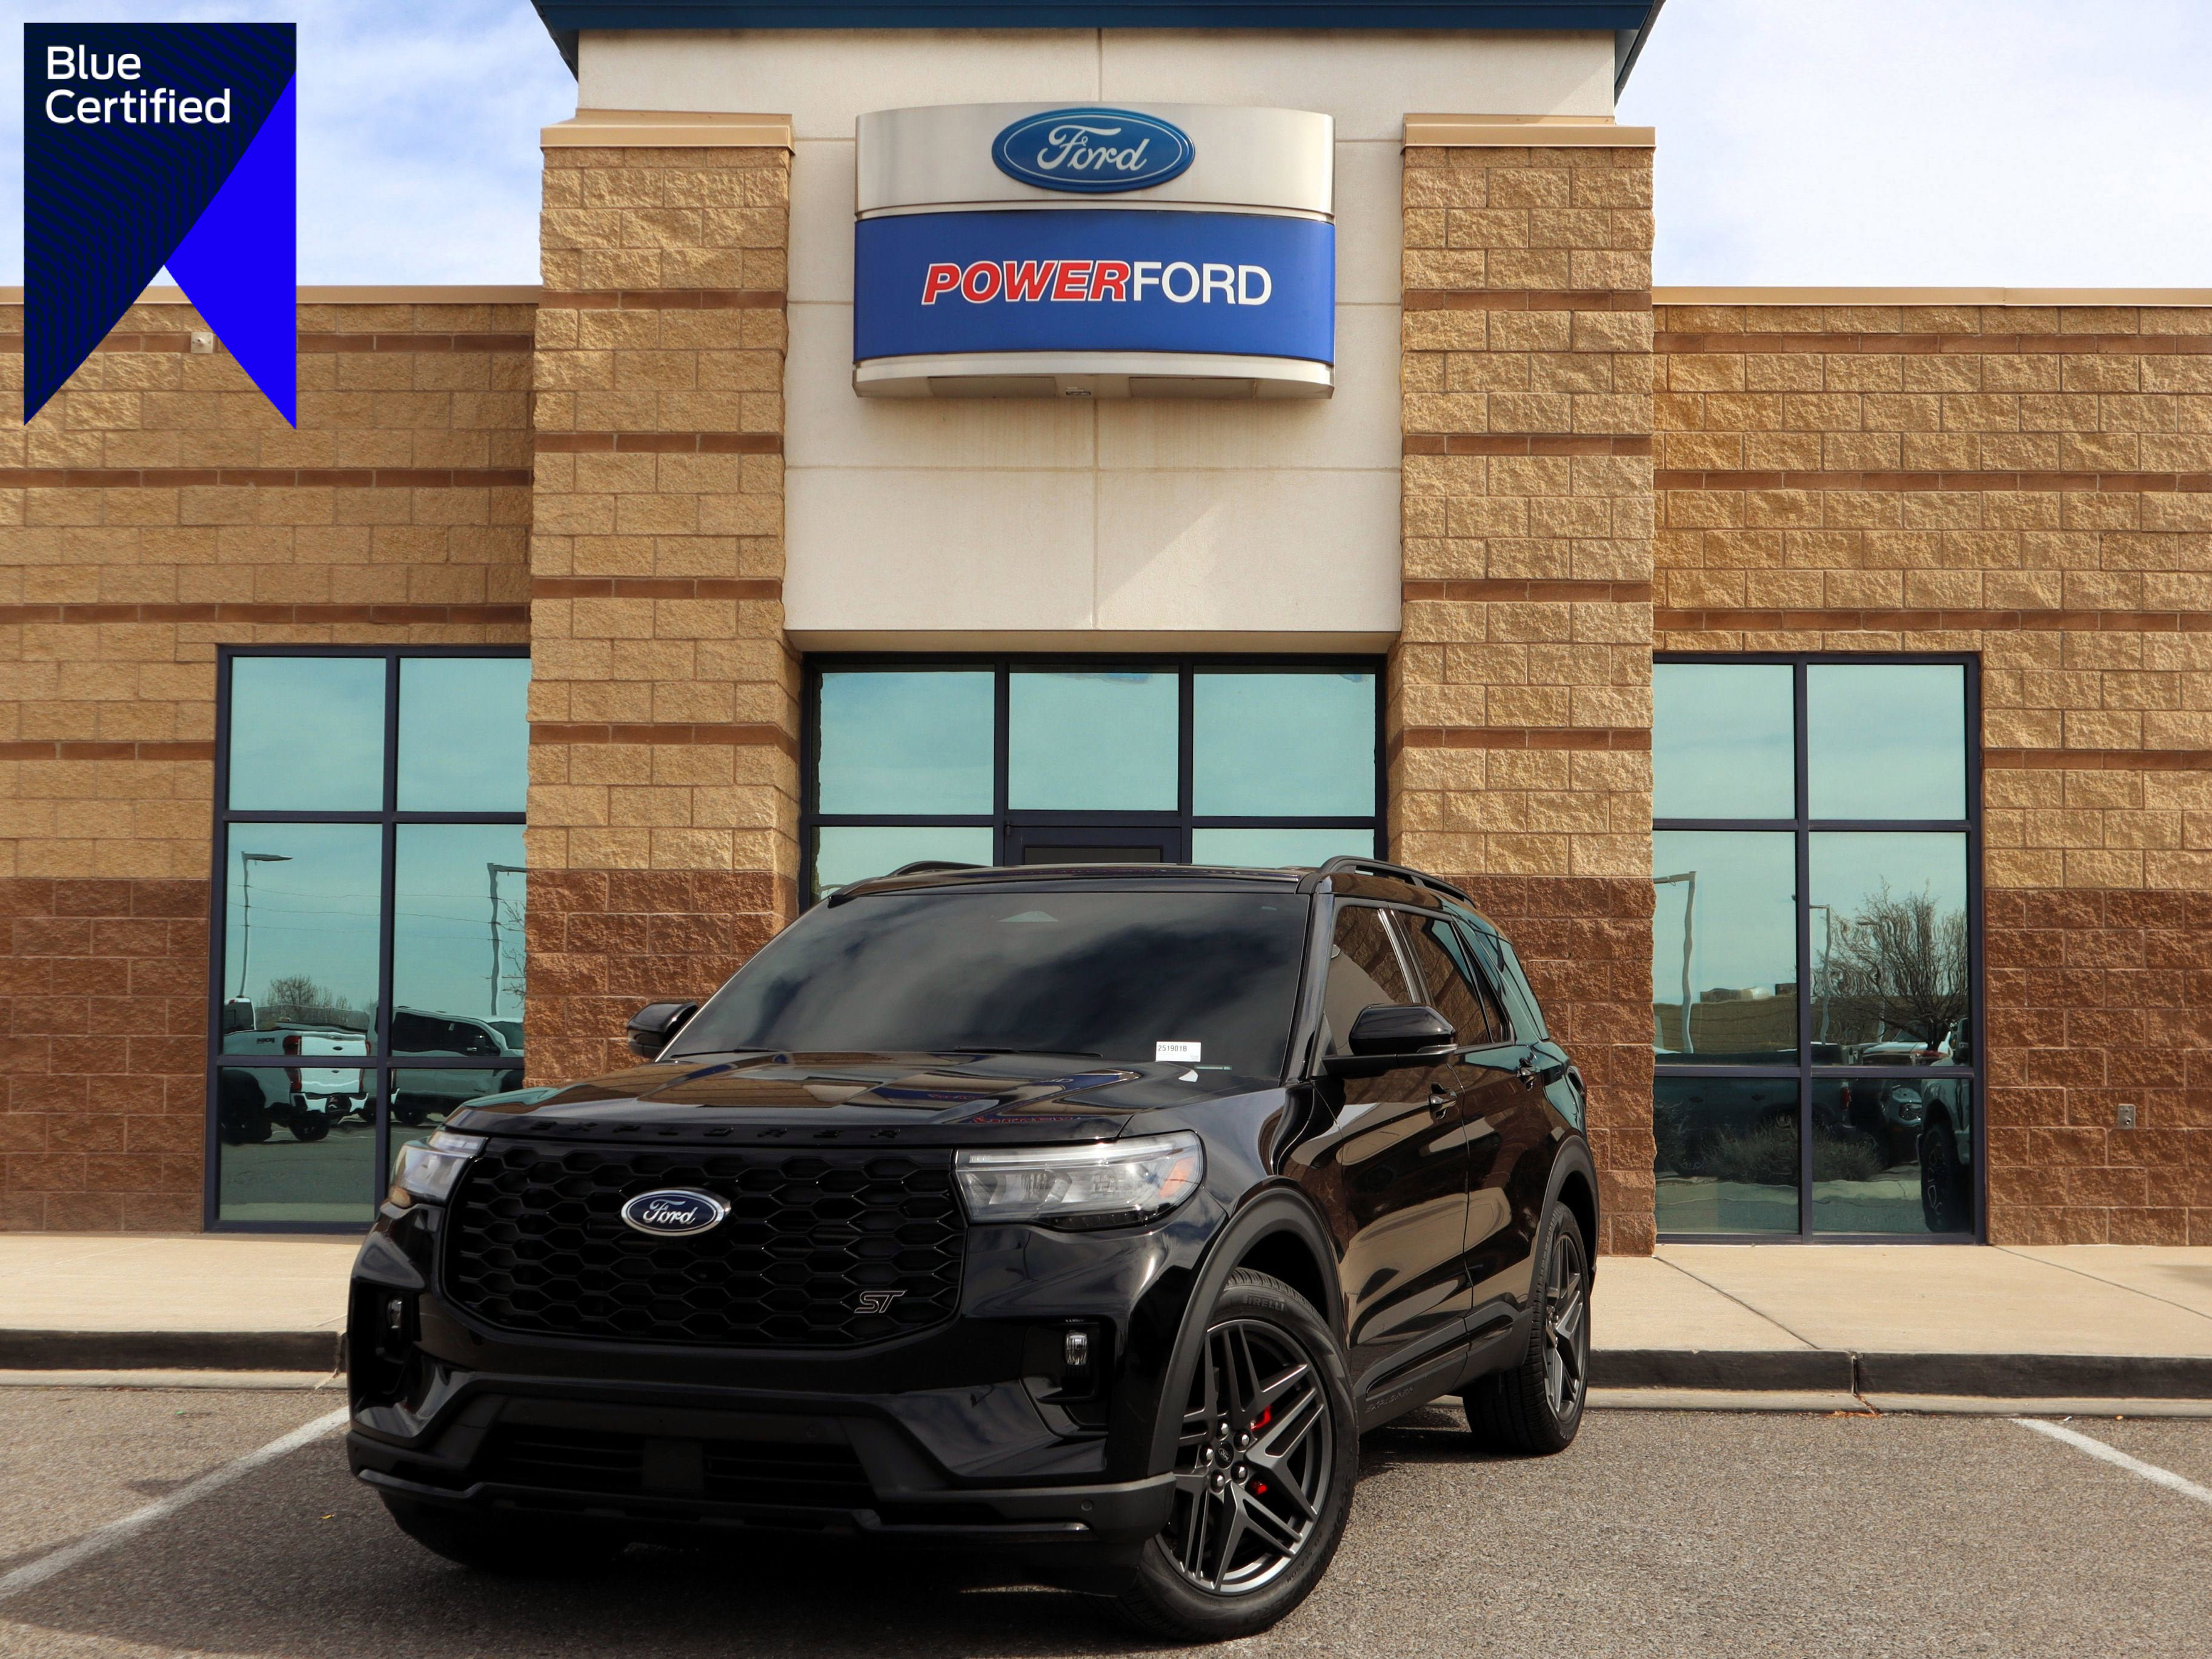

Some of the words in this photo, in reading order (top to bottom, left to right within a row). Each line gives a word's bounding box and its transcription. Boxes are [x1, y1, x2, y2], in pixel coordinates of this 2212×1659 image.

[1035, 124, 1148, 172] Ford
[921, 260, 1272, 305] POWERFORD
[643, 1199, 698, 1225] Ford
[854, 1290, 907, 1314] ST
